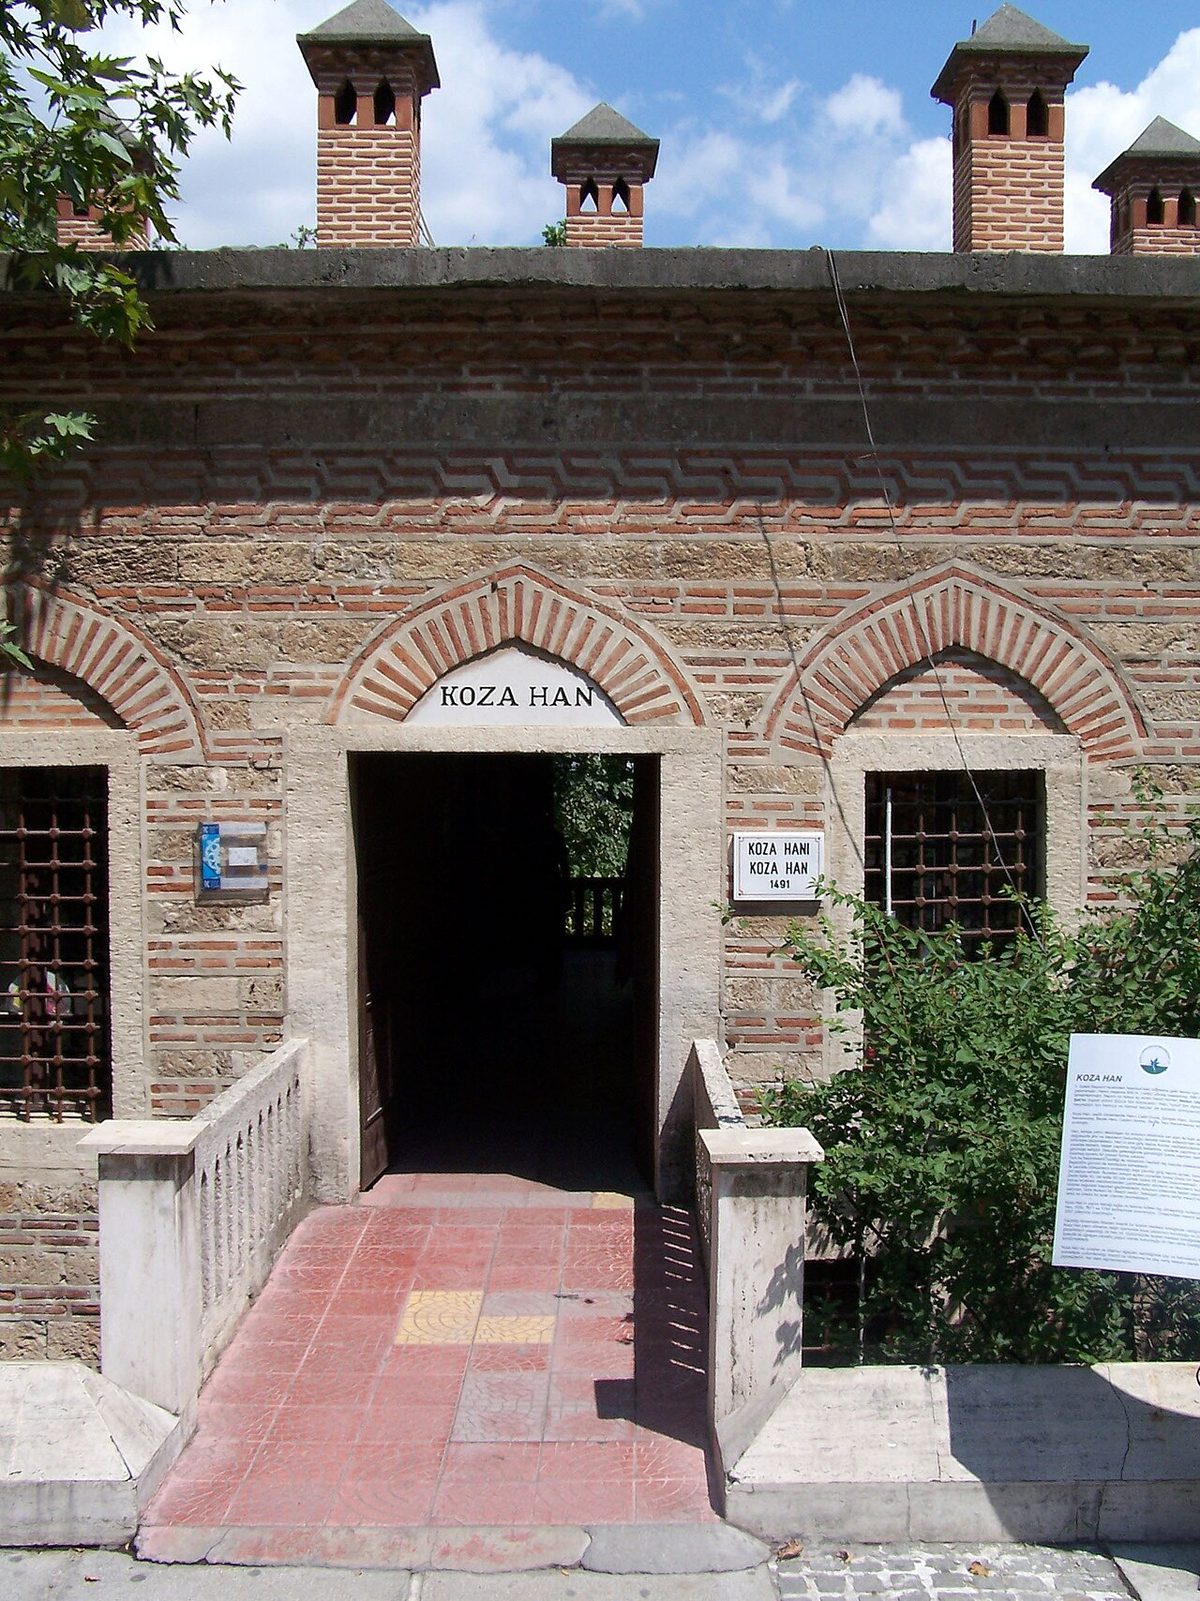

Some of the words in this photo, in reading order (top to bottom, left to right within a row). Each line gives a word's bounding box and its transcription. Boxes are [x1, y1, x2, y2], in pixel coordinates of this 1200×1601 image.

[440, 686, 519, 707] KOZA
[528, 686, 594, 707] HAN
[748, 842, 777, 856] KOZA
[784, 842, 810, 856] HANI
[749, 861, 778, 875] KOZA
[785, 861, 808, 875] HAN
[769, 879, 790, 889] 1491
[1076, 1073, 1101, 1082] KOZA
[1102, 1074, 1123, 1083] HAN
